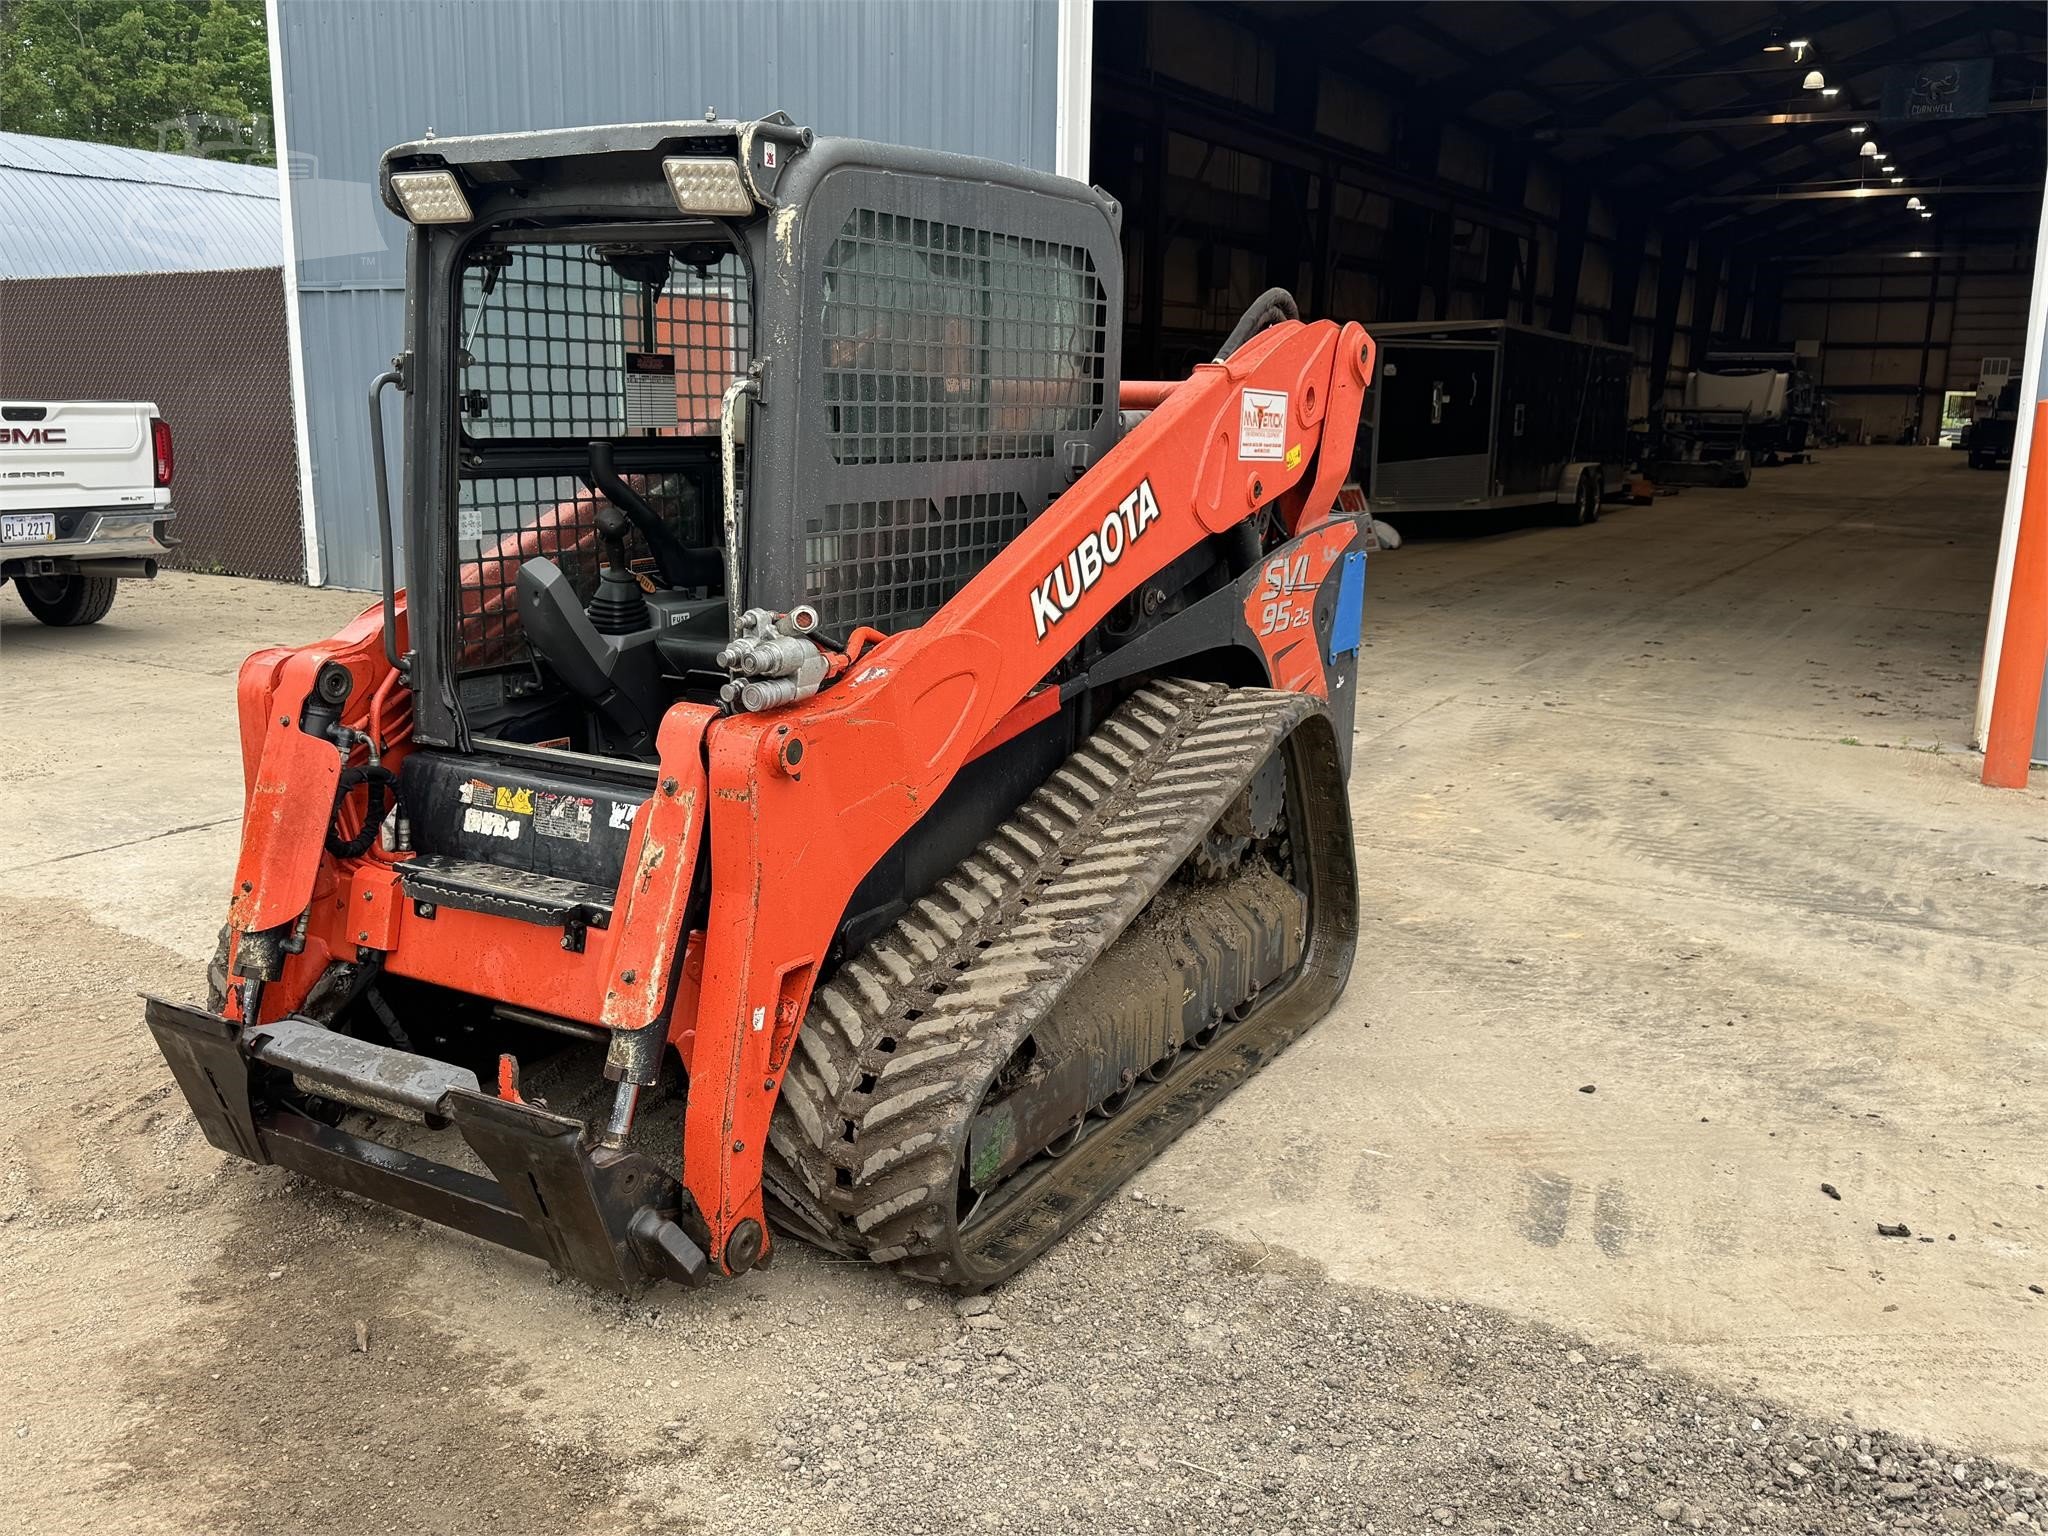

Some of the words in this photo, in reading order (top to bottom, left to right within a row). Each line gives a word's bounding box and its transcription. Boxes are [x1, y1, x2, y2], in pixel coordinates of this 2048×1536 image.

[1911, 102, 1954, 113] CORNWELL
[5, 523, 24, 537] PLJ
[27, 522, 51, 536] 2217
[1030, 477, 1160, 640] KUBOTA
[1260, 555, 1320, 602] SVL
